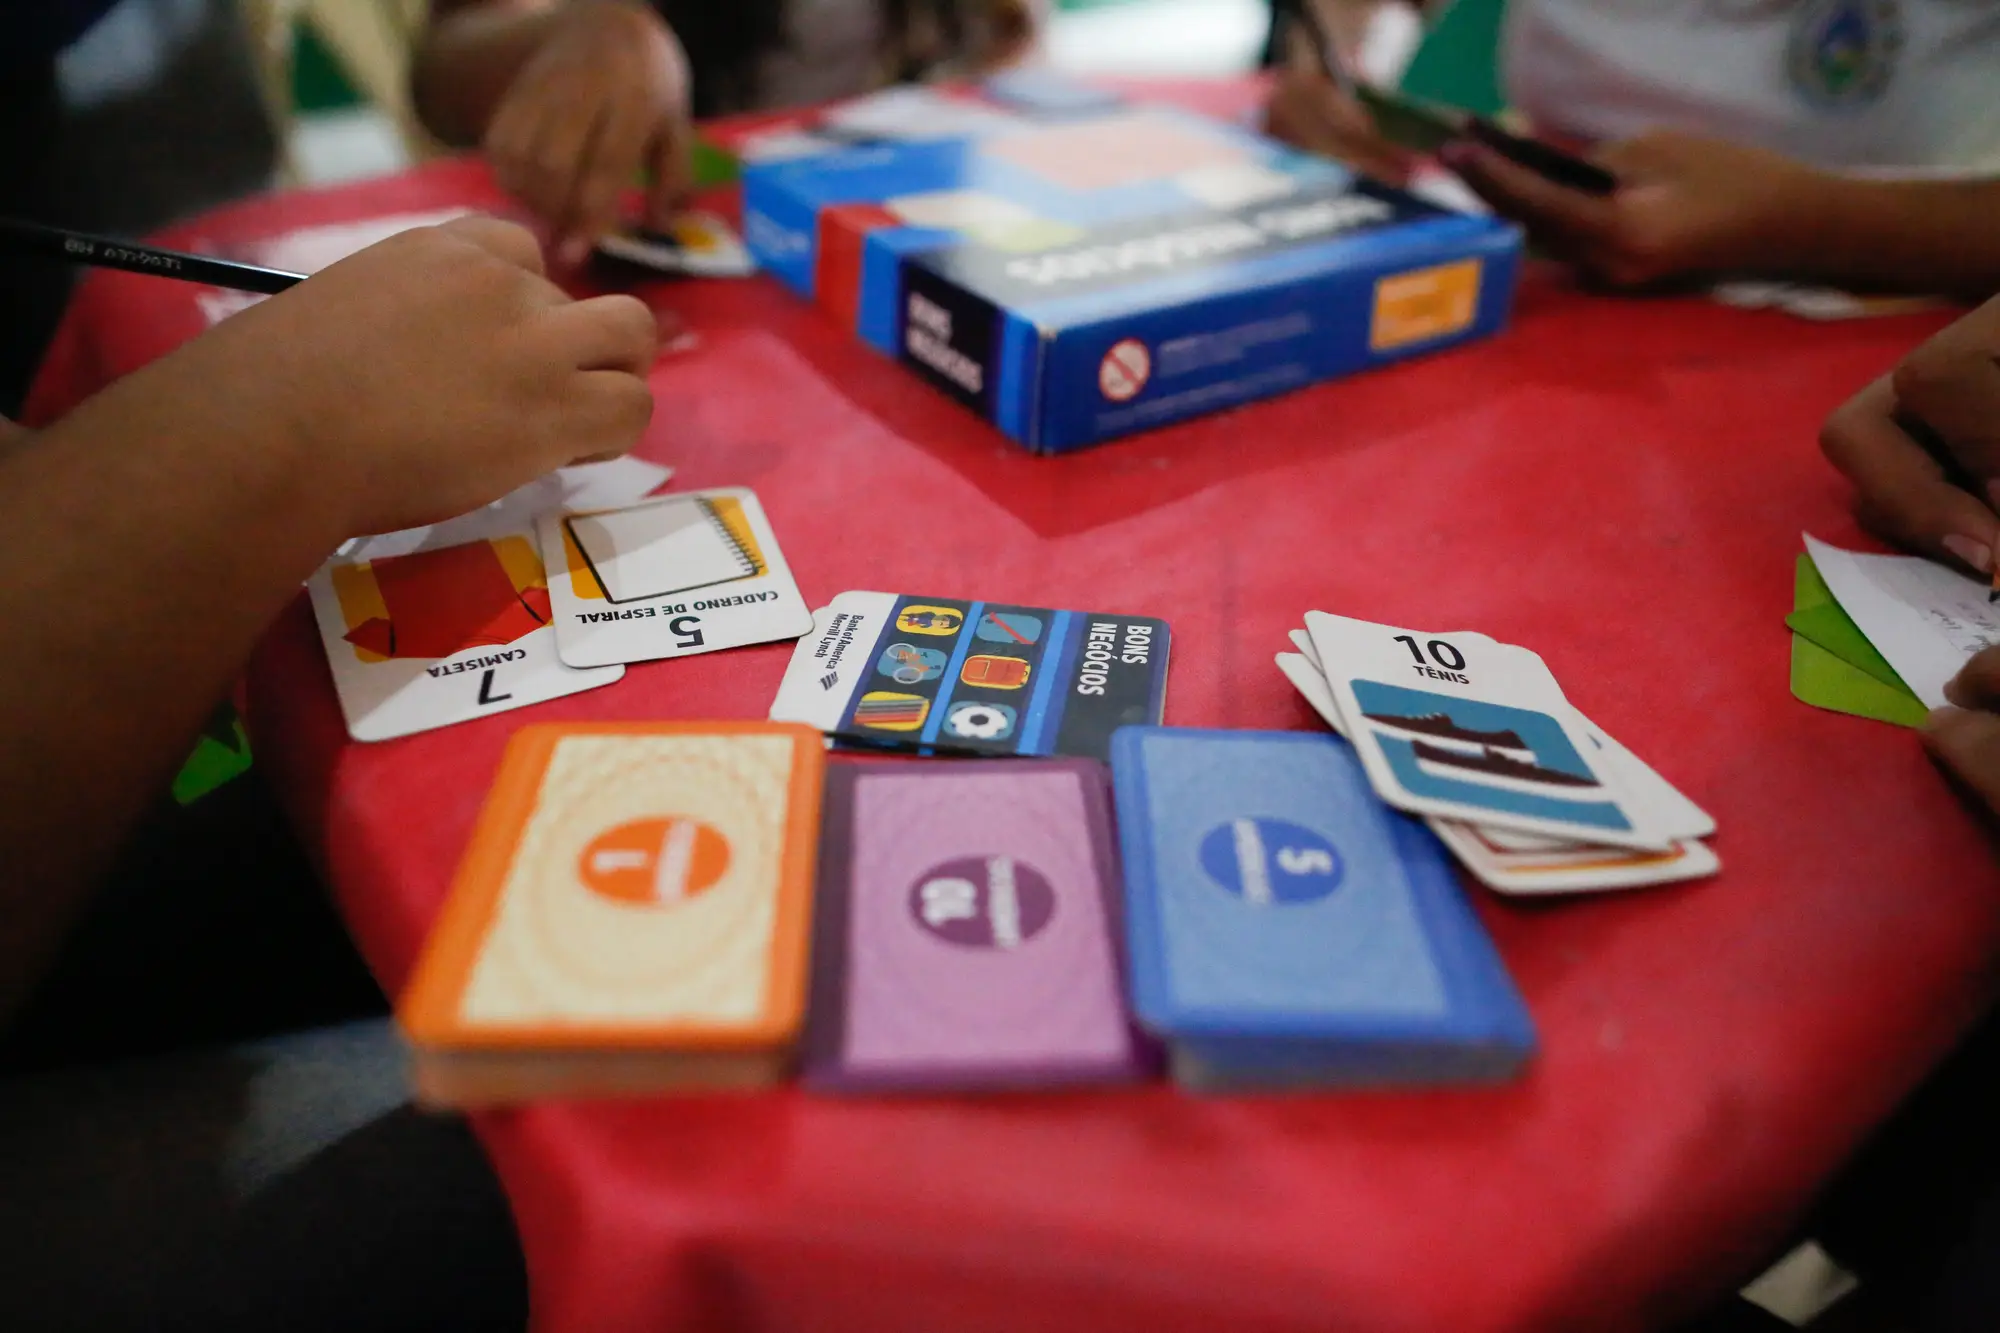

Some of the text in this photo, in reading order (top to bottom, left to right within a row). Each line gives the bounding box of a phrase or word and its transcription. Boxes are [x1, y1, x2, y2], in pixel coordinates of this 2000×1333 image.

[575, 590, 779, 624] CADERNO DE ESPIRAL
[669, 615, 705, 649] 5
[814, 613, 849, 658] Merrill Lynch
[1121, 624, 1153, 665] BONS
[425, 647, 527, 680] CAMISETA
[1077, 622, 1119, 696] NEGÓCIOS
[1393, 634, 1466, 670] 10
[477, 668, 513, 705] 7
[1413, 665, 1470, 685] TÊNIS
[1276, 846, 1335, 877] 5
